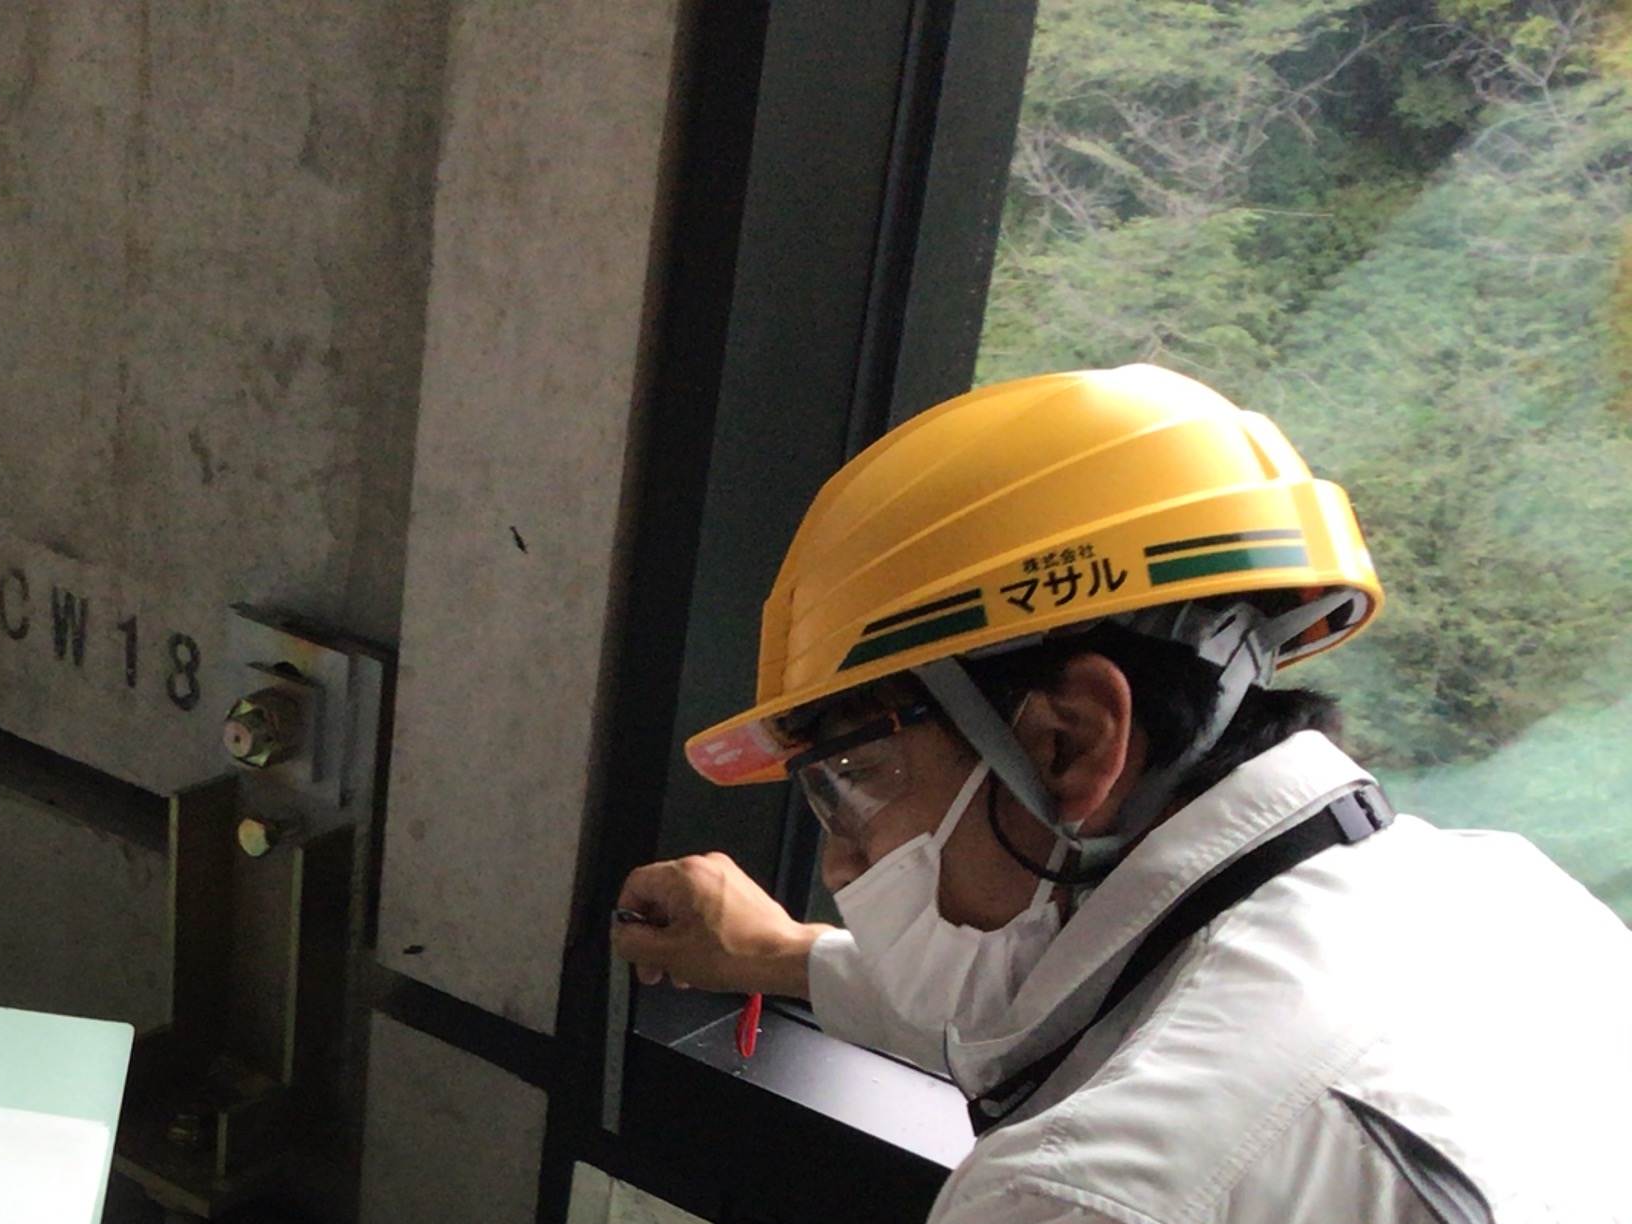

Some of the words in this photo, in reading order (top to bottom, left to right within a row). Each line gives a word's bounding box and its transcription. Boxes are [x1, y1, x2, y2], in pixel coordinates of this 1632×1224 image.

[1023, 544, 1095, 573] 株式会社
[1000, 558, 1127, 614] マサル
